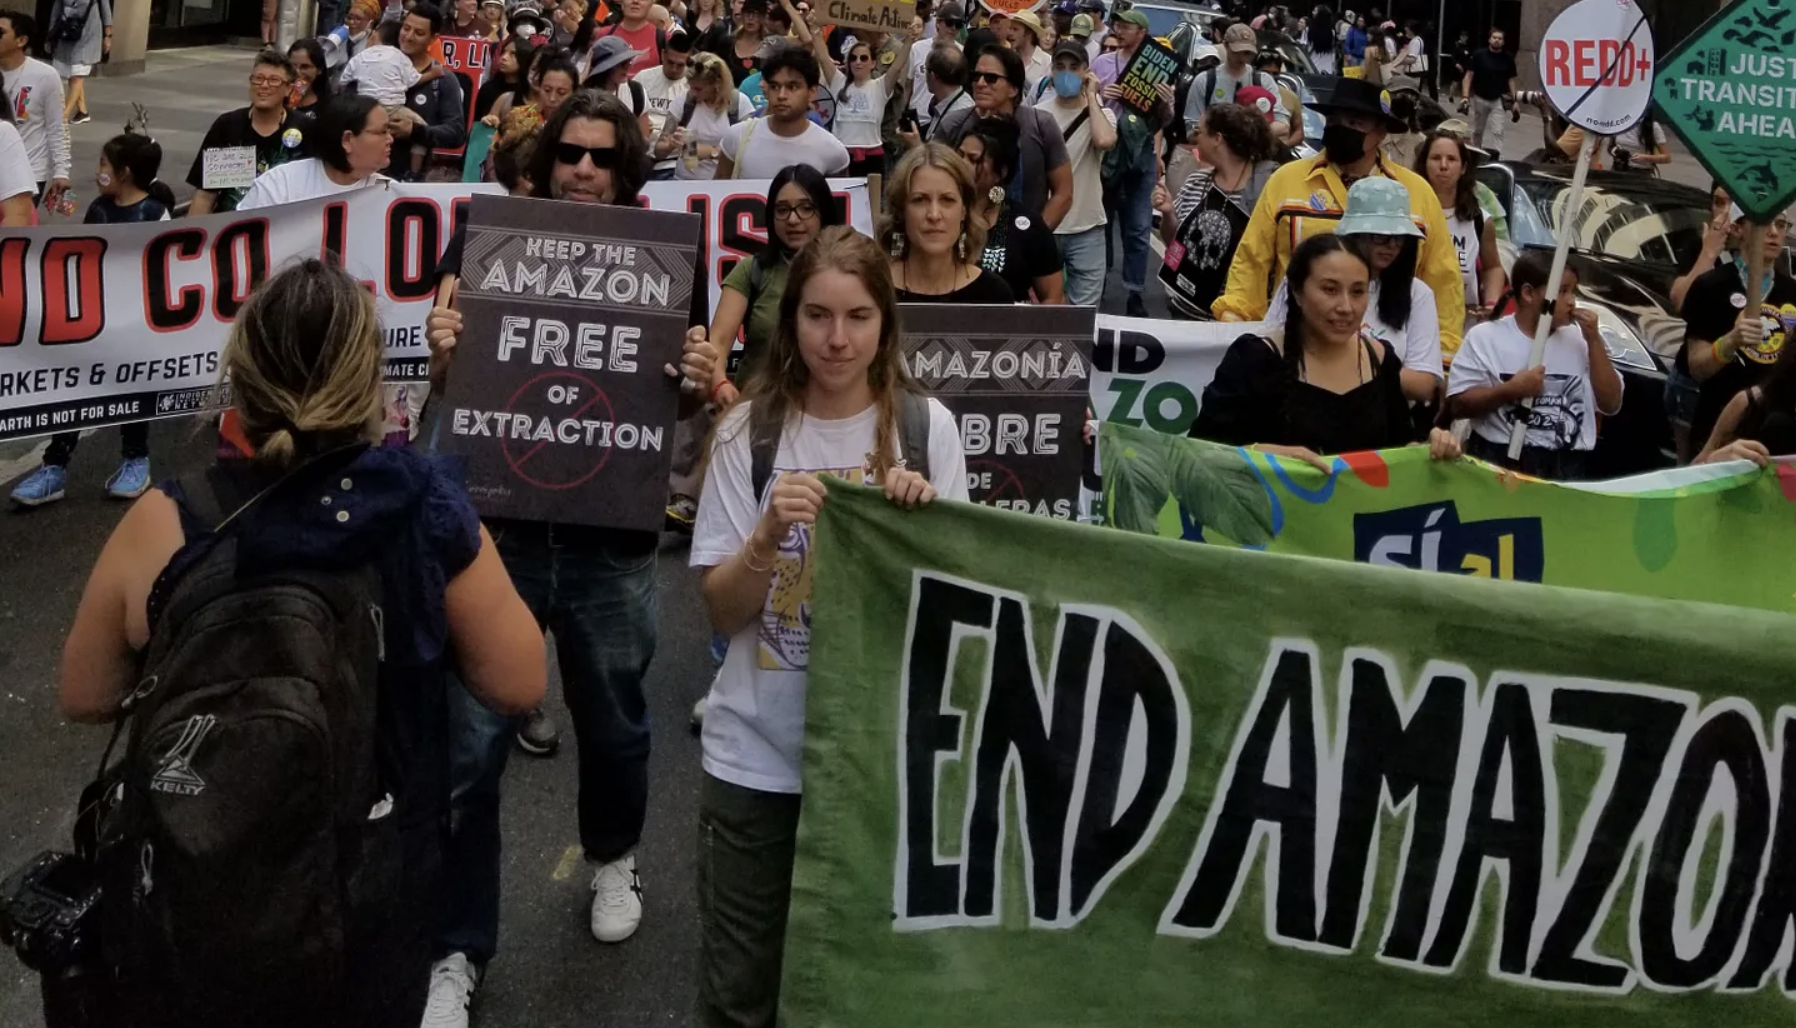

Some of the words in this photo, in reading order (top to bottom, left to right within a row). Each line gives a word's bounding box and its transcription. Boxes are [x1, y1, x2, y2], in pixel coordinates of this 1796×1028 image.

[828, 1, 877, 25] Climate
[1131, 55, 1170, 85] END
[1141, 44, 1179, 75] BIDEN
[1544, 39, 1651, 88] REDD+
[1730, 53, 1796, 80] JUST
[1120, 83, 1152, 112] FUELS
[1124, 71, 1158, 101] FOSSIL
[1680, 78, 1796, 109] TRANSIT
[526, 237, 586, 261] KEEP
[593, 244, 637, 266] THE
[480, 259, 670, 306] AMAZON
[497, 315, 641, 373] FREE
[89, 363, 106, 386] &
[115, 350, 218, 384] OFFSETS
[547, 385, 579, 405] OF
[36, 413, 48, 427] IS
[53, 409, 76, 425] NOT
[81, 406, 104, 420] FOR
[108, 401, 140, 417] SALE
[452, 408, 664, 452] EXTRACTION
[954, 413, 1060, 455] BRE
[967, 471, 992, 490] DE
[892, 569, 1191, 933] END
[150, 780, 206, 797] KELTY
